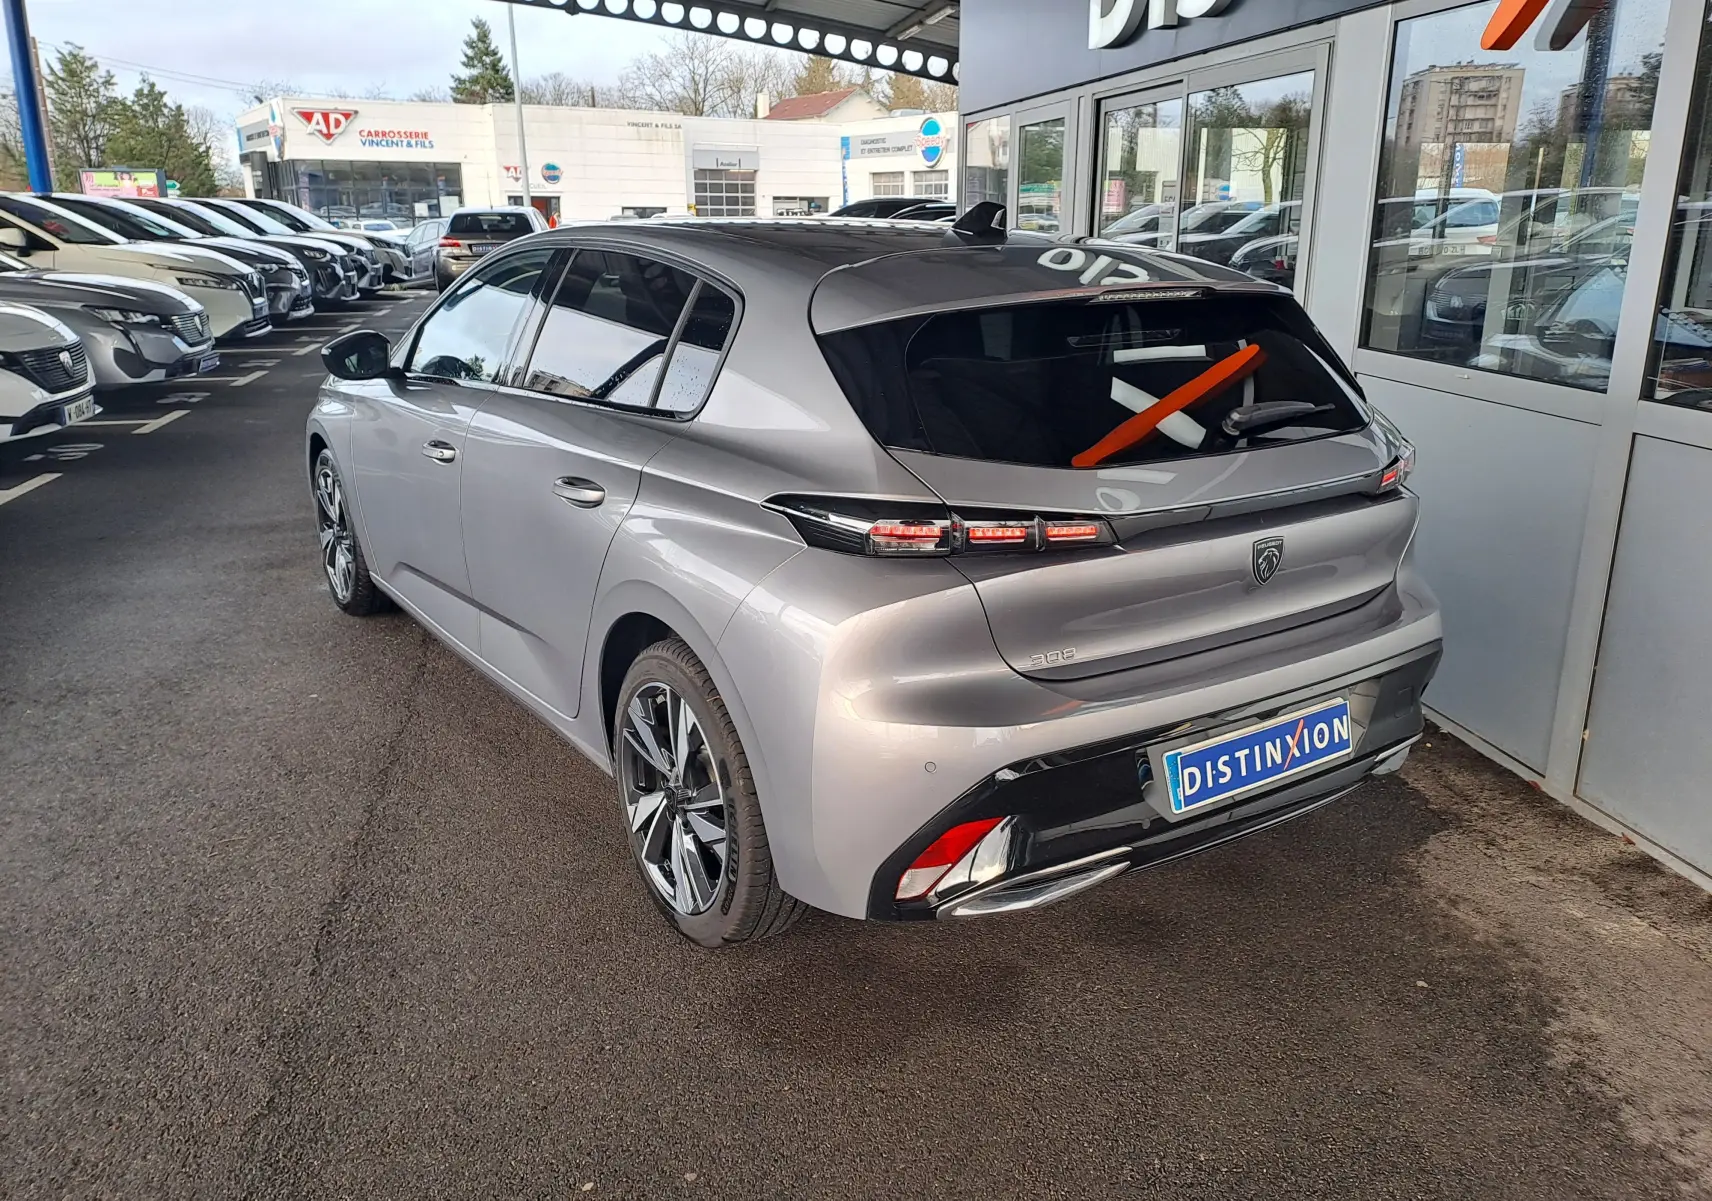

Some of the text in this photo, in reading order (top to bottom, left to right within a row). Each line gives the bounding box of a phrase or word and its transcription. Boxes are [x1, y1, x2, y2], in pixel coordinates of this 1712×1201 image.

[306, 112, 347, 135] AD
[359, 129, 429, 140] CARROSSERIE
[360, 138, 434, 149] VINCENT & FILS
[1257, 541, 1283, 550] PEUGEOT
[1029, 648, 1076, 667] 308
[1183, 714, 1349, 797] DISTINXION
